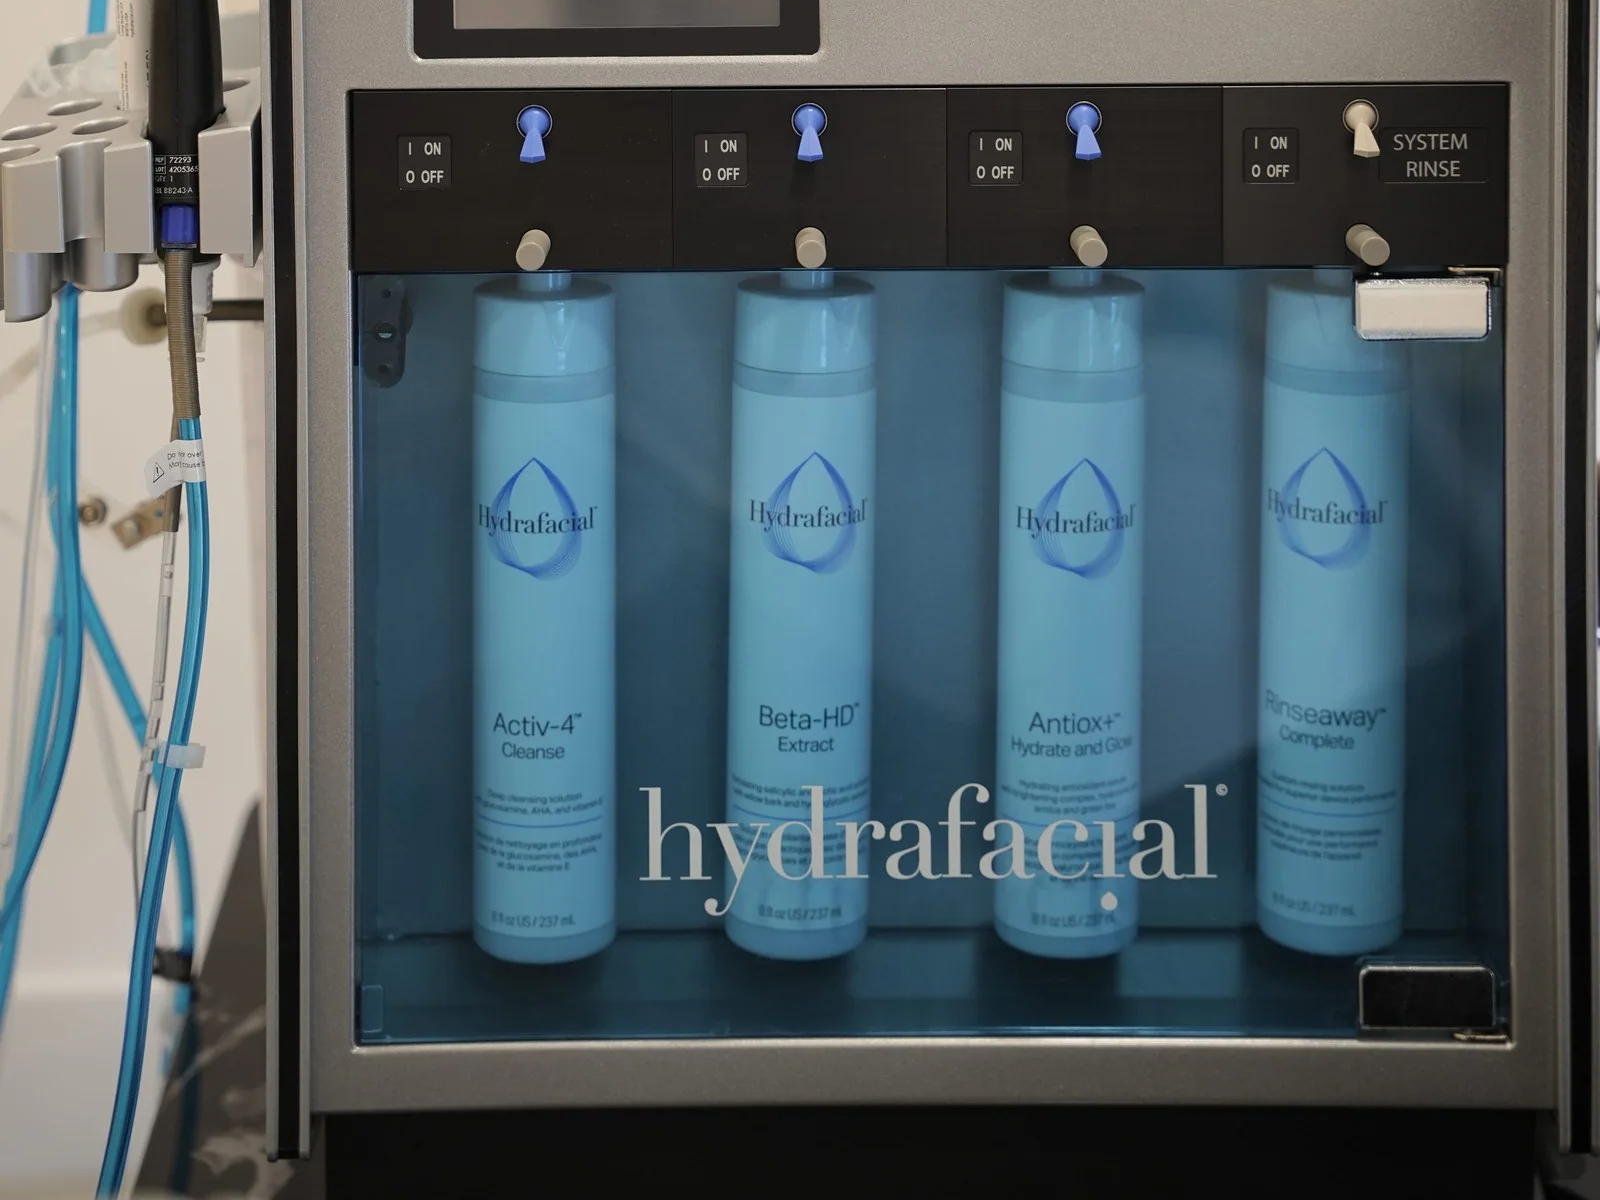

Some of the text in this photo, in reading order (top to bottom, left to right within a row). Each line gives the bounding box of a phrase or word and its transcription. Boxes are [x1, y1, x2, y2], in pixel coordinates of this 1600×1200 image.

[424, 141, 442, 156] ON
[719, 139, 738, 153] ON
[994, 137, 1013, 152] ON
[1270, 136, 1288, 150] ON
[1393, 133, 1468, 151] SYSTEM
[169, 156, 192, 164] 72293
[717, 167, 741, 182] OFF
[991, 165, 1015, 180] OFF
[1266, 164, 1290, 178] OFF
[1406, 160, 1461, 178] RINSE
[420, 170, 445, 184] OFF
[778, 736, 834, 753] Extract
[1279, 724, 1355, 751] Complete
[501, 741, 565, 760] Cleanse
[1011, 736, 1071, 758] Hydrate
[1074, 742, 1104, 758] and
[539, 914, 559, 929] 237
